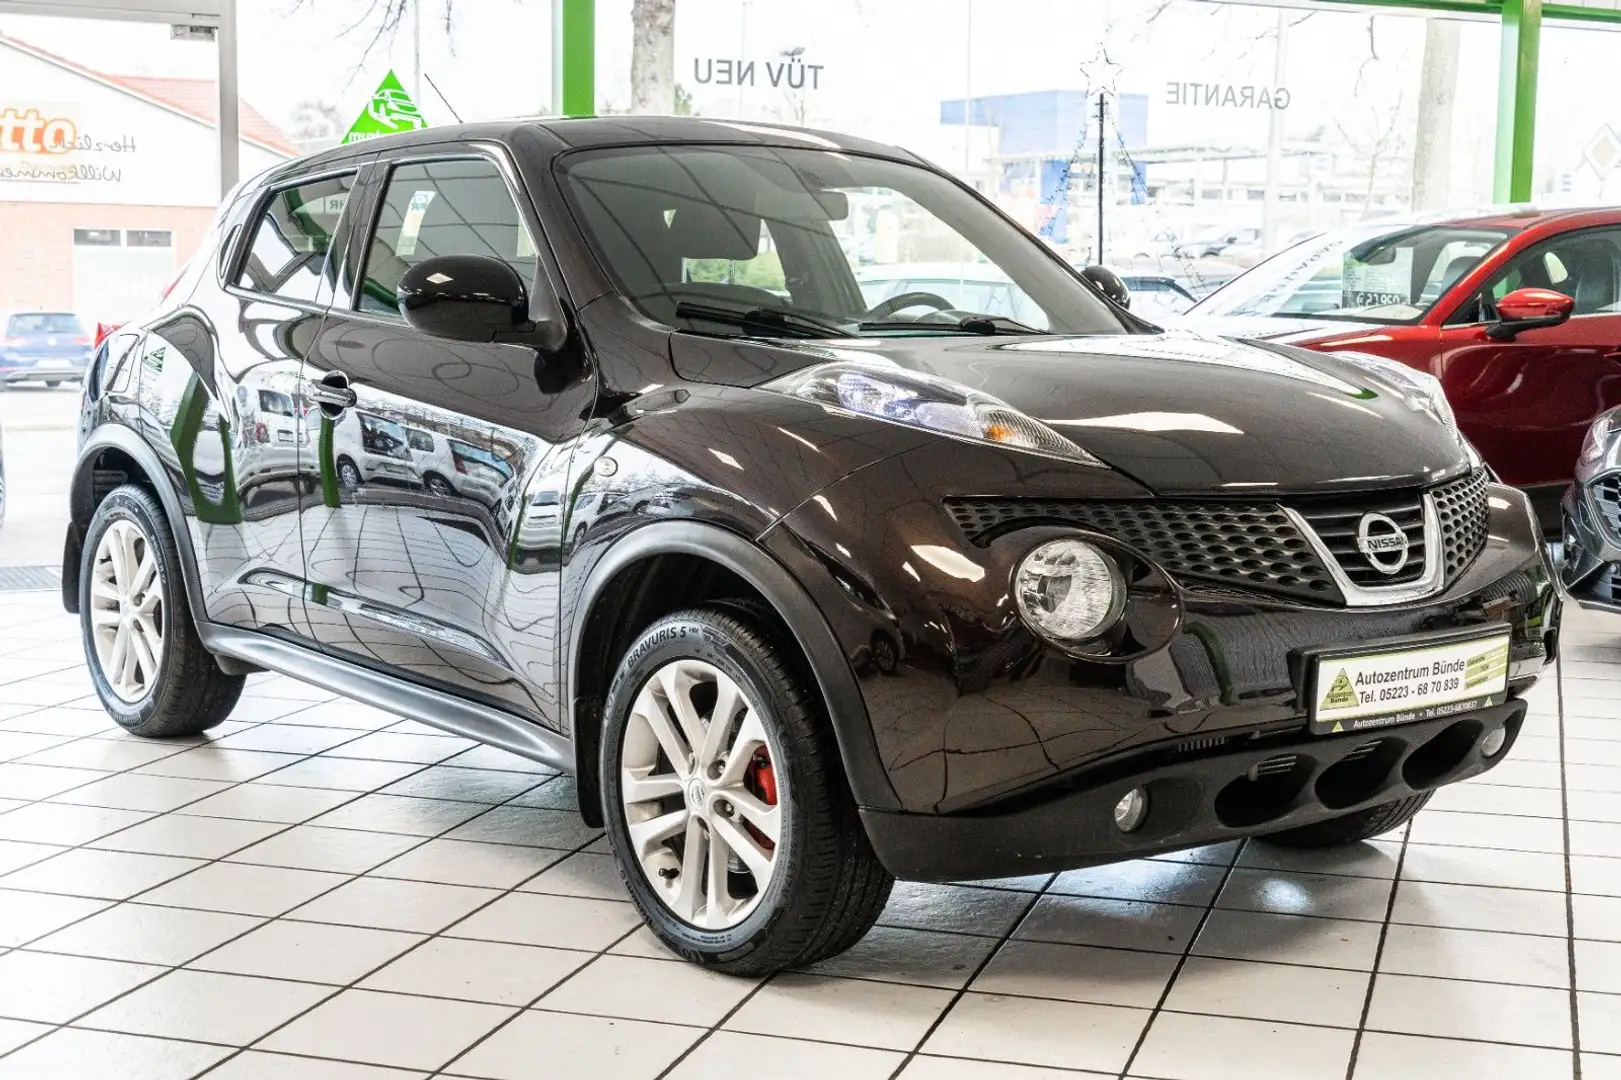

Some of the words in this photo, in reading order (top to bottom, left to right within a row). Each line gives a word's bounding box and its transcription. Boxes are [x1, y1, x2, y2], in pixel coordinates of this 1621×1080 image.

[1355, 665, 1429, 686] Autozentrum
[1432, 659, 1465, 675] Bünde
[1359, 690, 1376, 704] Tel.
[1380, 685, 1408, 701] 05223
[1417, 683, 1428, 696] 68
[1431, 680, 1441, 693] 70
[1444, 677, 1459, 691] 839
[1353, 715, 1394, 729] Autozentrum
[1396, 711, 1416, 722] Bünde
